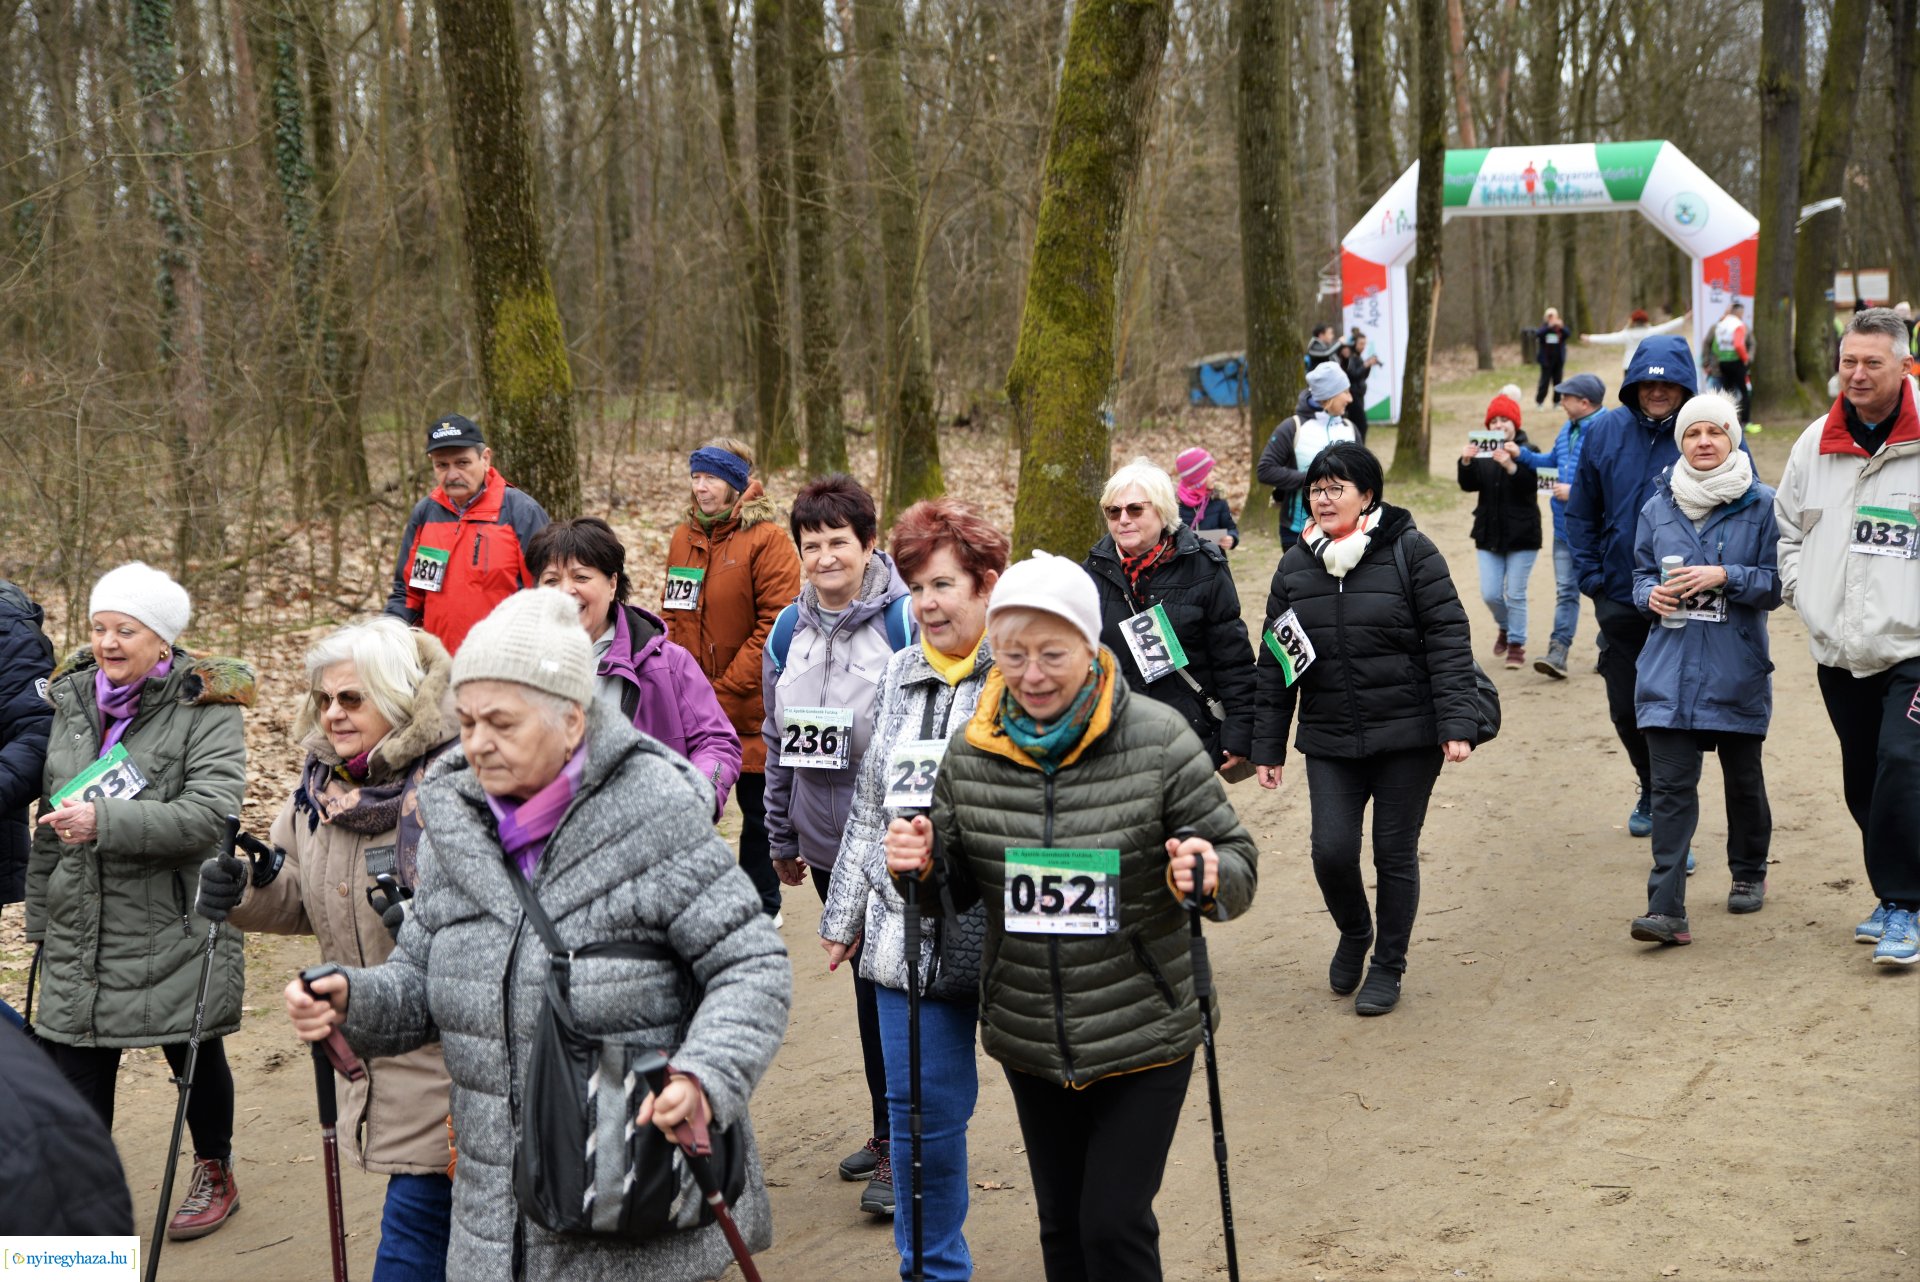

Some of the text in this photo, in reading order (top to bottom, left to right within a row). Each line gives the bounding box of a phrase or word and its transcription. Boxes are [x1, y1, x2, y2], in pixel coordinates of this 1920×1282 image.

[1856, 520, 1910, 547] 033
[414, 558, 438, 581] 080
[667, 579, 693, 600] 079
[1685, 587, 1718, 611] 32
[1131, 615, 1171, 661] 047
[1276, 625, 1308, 673] 046
[784, 724, 838, 755] 236
[82, 769, 126, 803] 93
[892, 760, 938, 792] 23
[1011, 874, 1097, 914] 052
